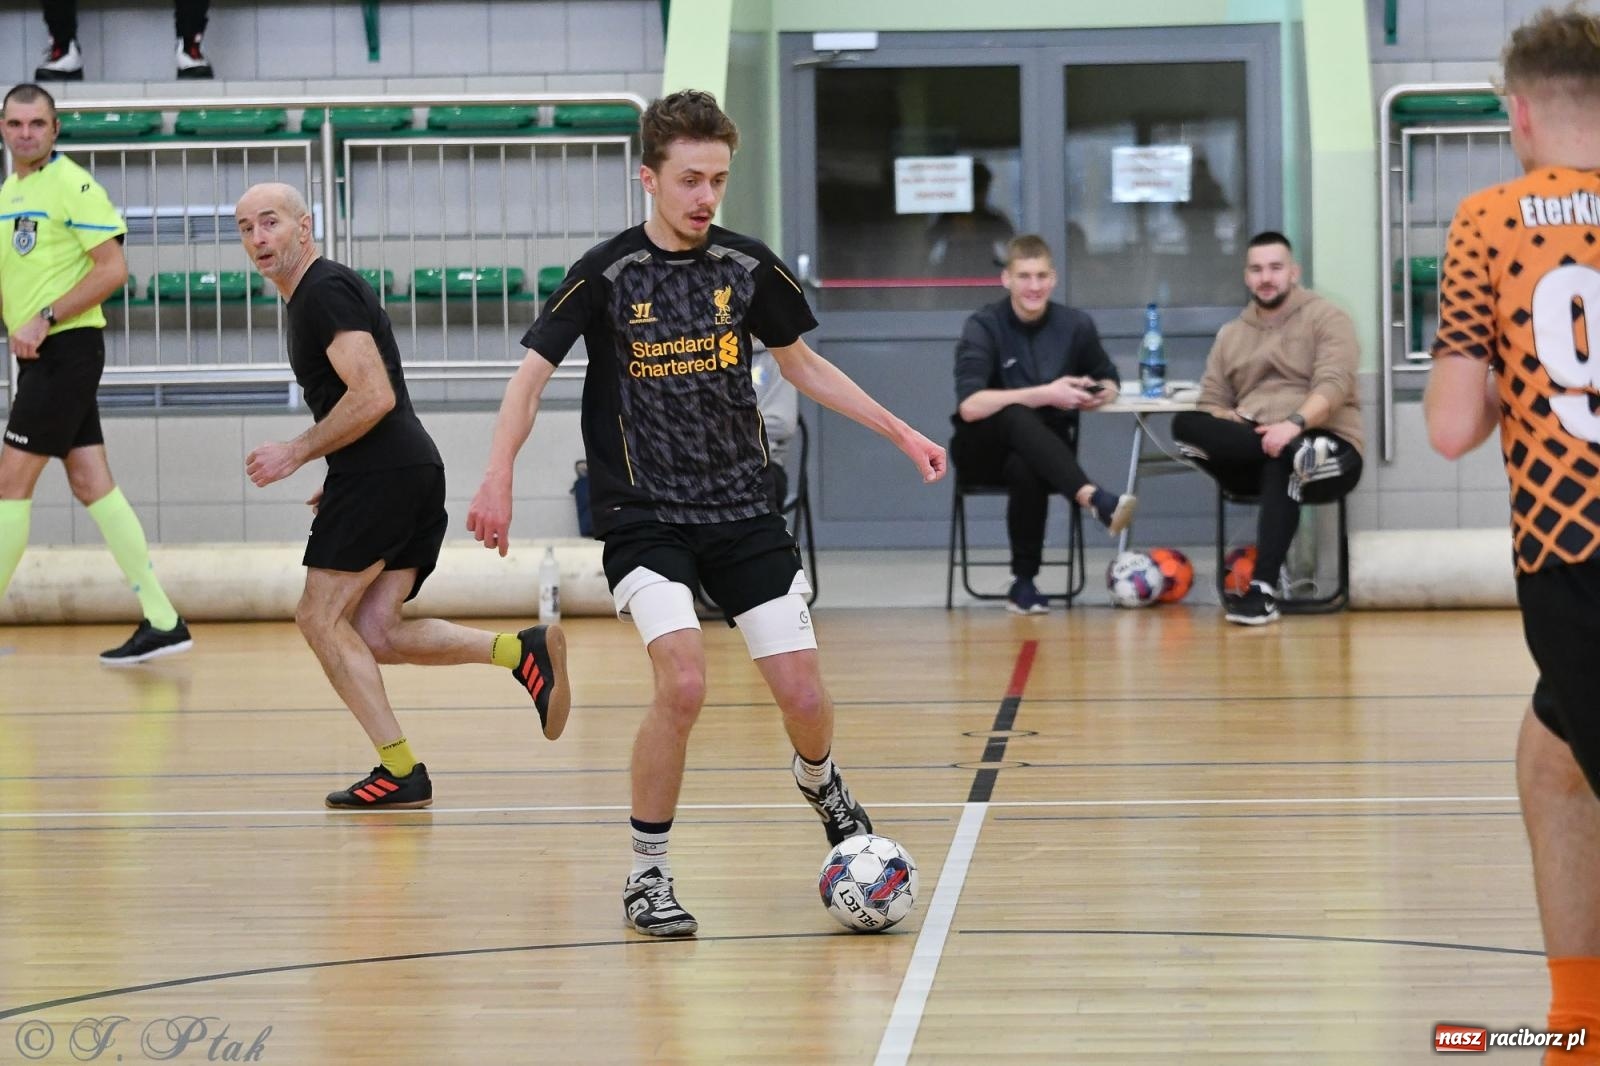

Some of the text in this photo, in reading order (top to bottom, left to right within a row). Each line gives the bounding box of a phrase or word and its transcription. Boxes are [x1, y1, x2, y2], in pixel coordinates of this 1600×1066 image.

[714, 316, 733, 325] LFC
[631, 333, 715, 358] Standard
[629, 354, 717, 378] Chartered
[839, 889, 879, 928] SELECT
